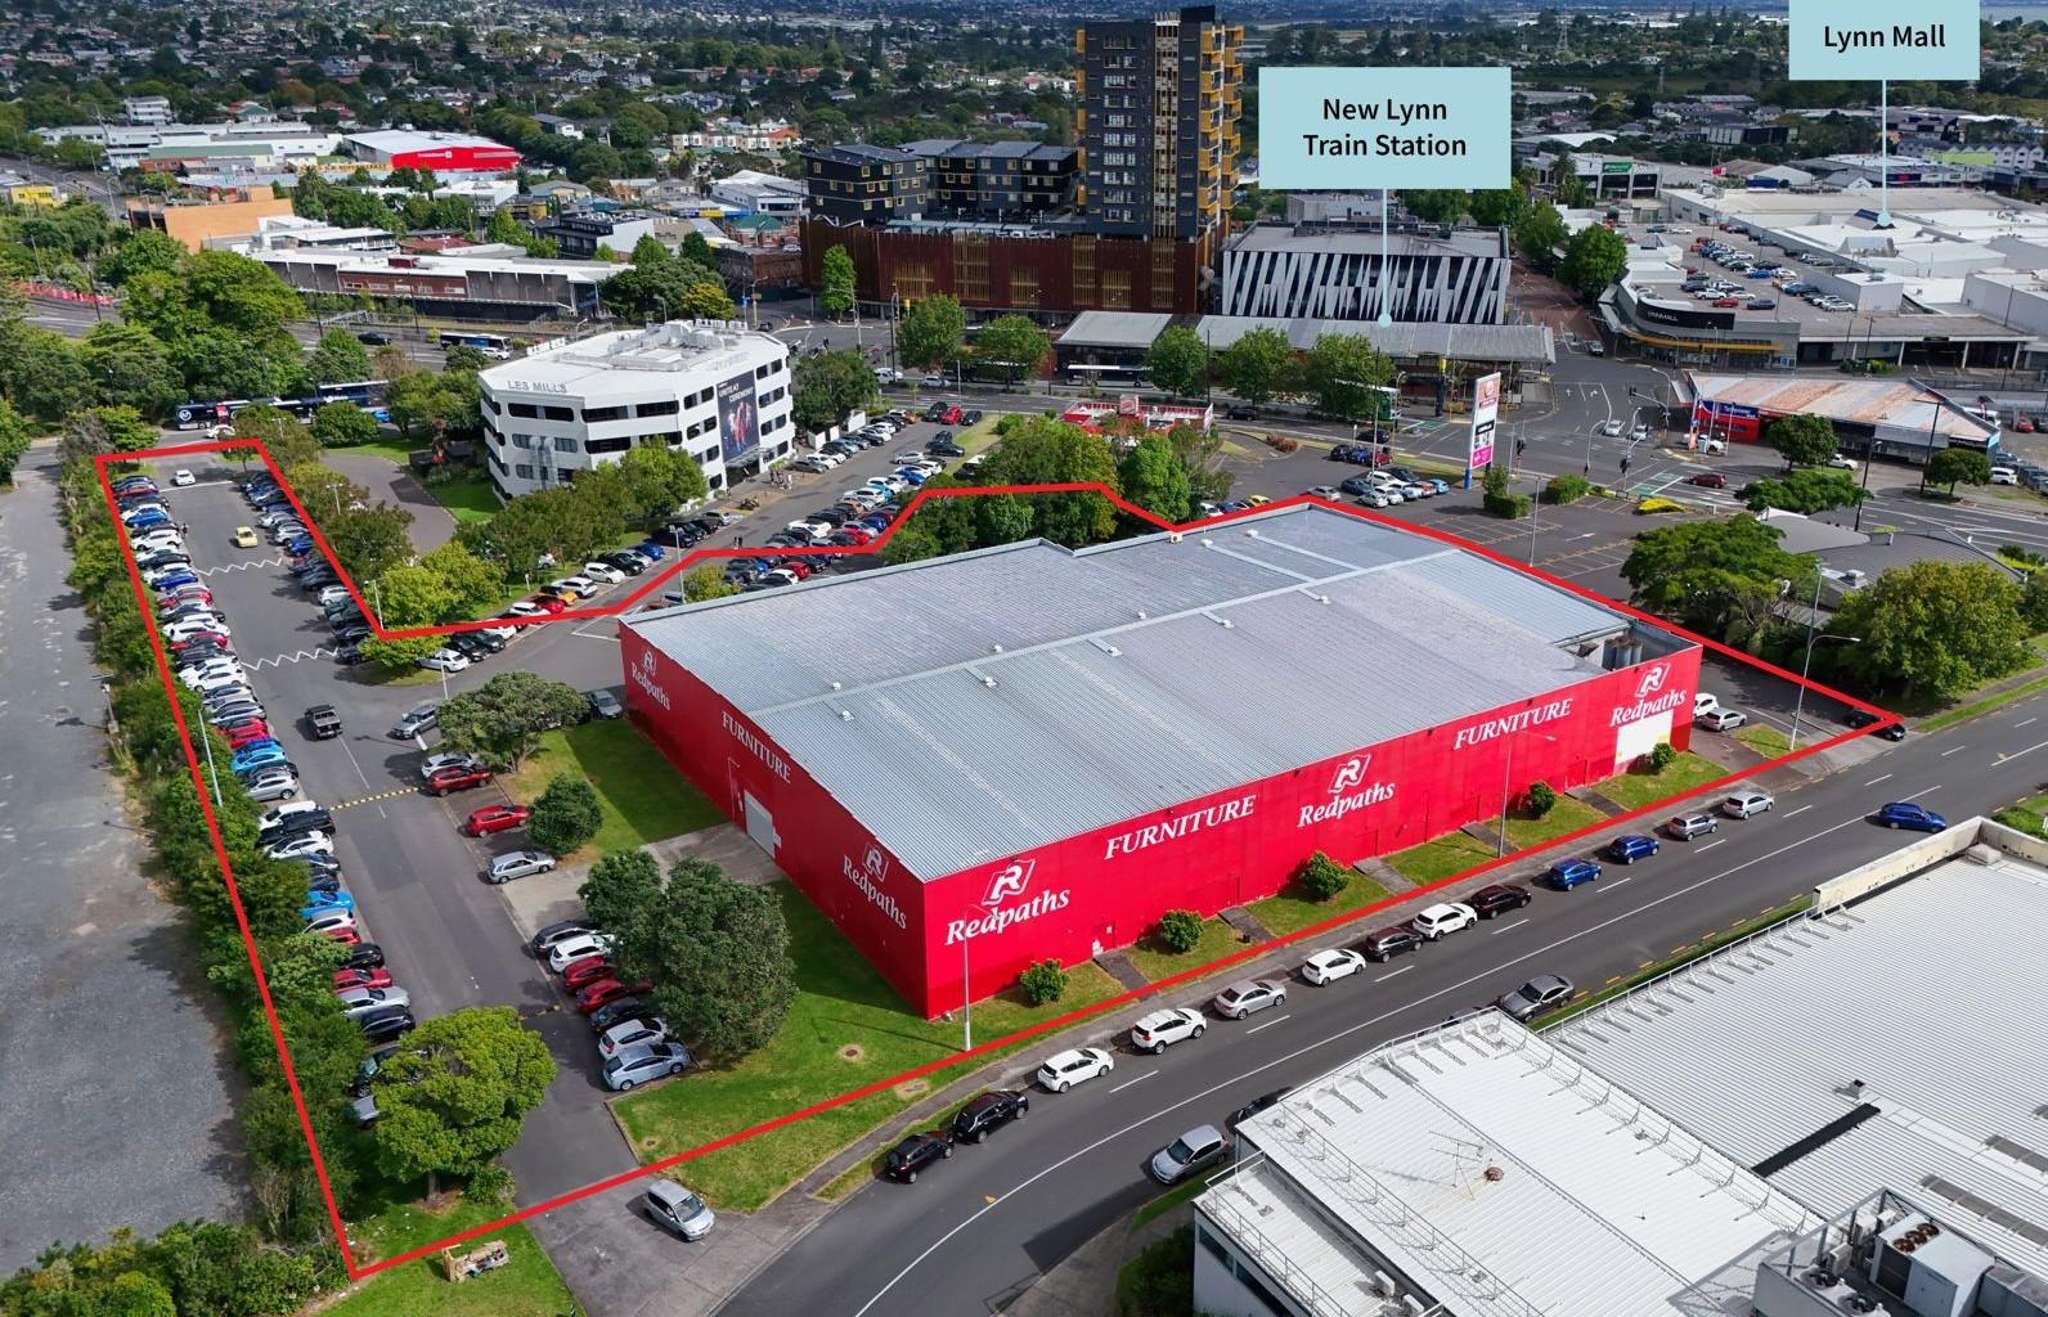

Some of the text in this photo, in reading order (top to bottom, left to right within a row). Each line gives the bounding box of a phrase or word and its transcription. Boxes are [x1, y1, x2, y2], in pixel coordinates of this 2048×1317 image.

[507, 380, 567, 393] LES MILLS
[631, 662, 671, 711] Redpaths
[1609, 689, 1687, 728] Redpaths
[722, 711, 792, 784] FURNITURE
[1453, 698, 1573, 750] FURNITURE
[1104, 795, 1256, 860] FURNITURE
[1297, 783, 1395, 828] Redpaths
[843, 855, 907, 929] Redpaths
[945, 889, 1071, 946] Redpaths
